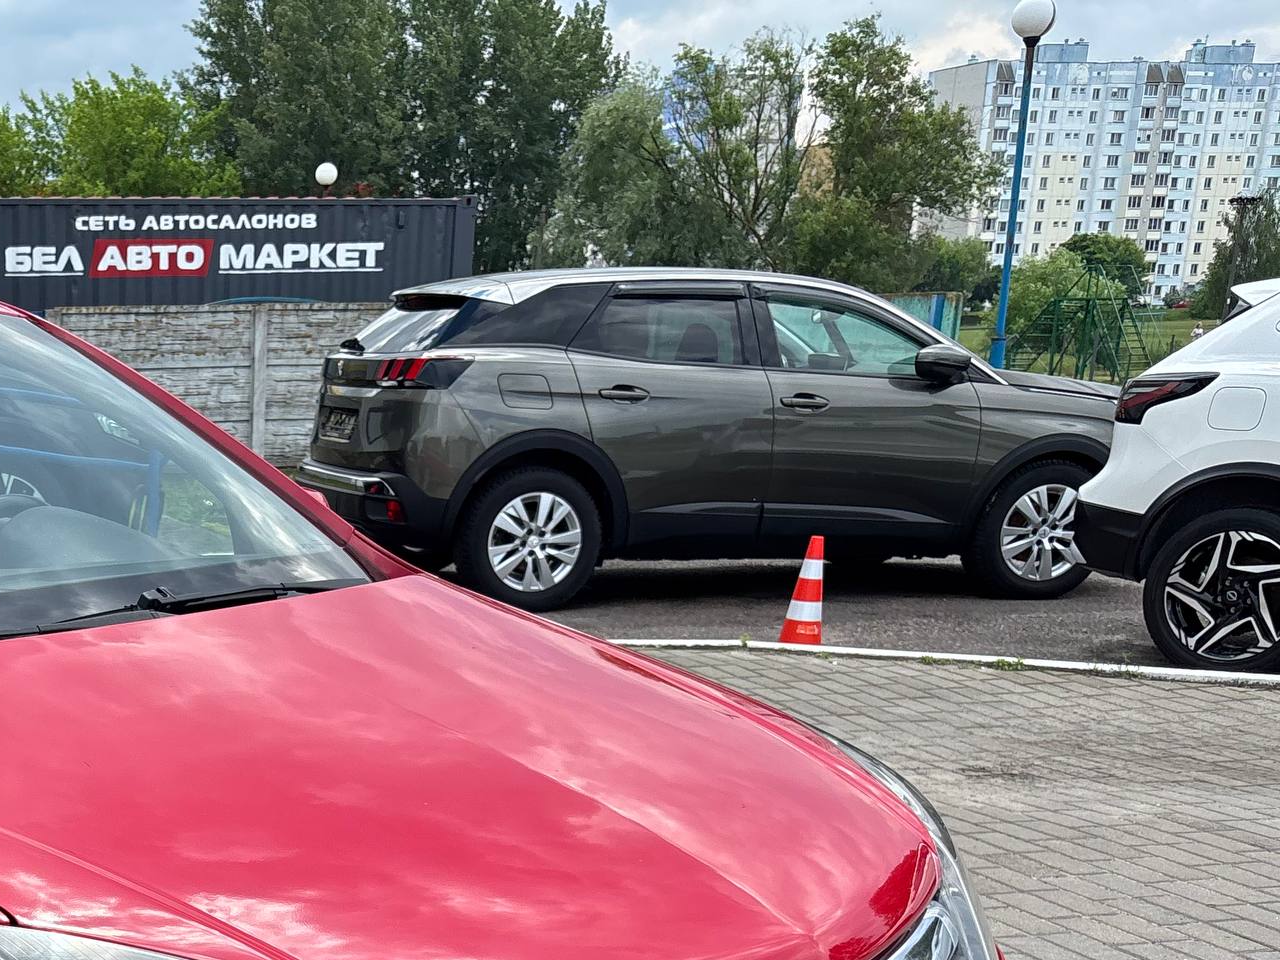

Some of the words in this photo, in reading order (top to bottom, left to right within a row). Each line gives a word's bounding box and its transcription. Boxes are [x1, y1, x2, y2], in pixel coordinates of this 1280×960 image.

[75, 214, 136, 232] СЕТЬ
[141, 214, 317, 232] АВТОСАЛОНОВ
[4, 246, 83, 273] БЕЛ
[96, 246, 206, 272] АВТО
[219, 241, 384, 271] МАРКЕТ
